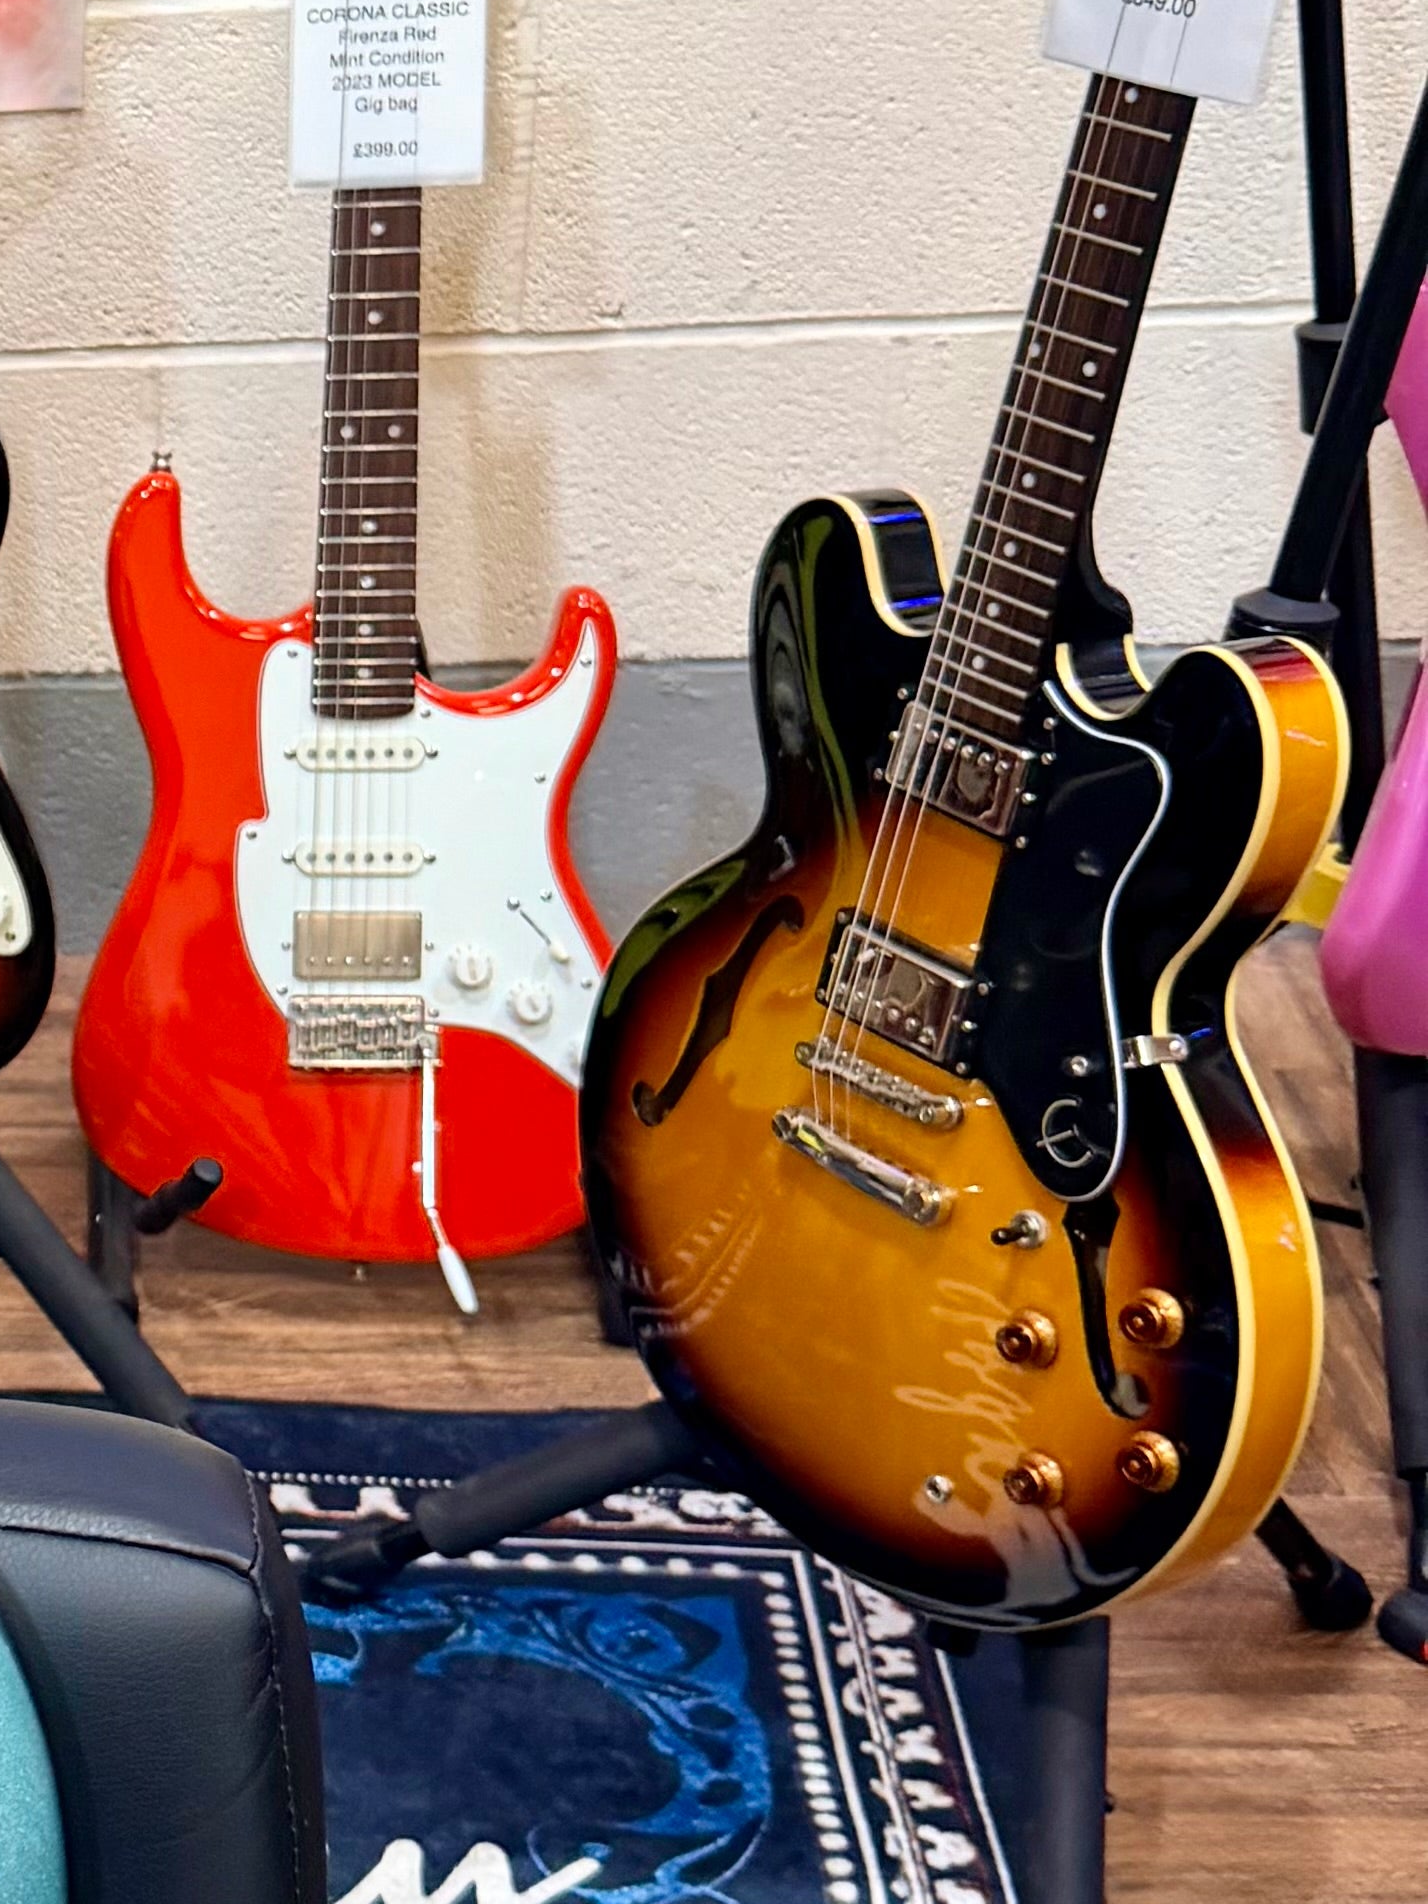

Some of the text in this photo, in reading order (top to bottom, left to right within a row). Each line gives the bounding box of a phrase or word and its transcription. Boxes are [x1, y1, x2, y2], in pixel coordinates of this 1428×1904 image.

[307, 1, 470, 24] CORONA CLASSIC
[339, 26, 437, 44] Firenza Red
[329, 48, 445, 68] Mint Condition
[332, 72, 442, 92] 2023 MODEL
[355, 95, 418, 114] Gig bag
[353, 141, 419, 159] £399.00
